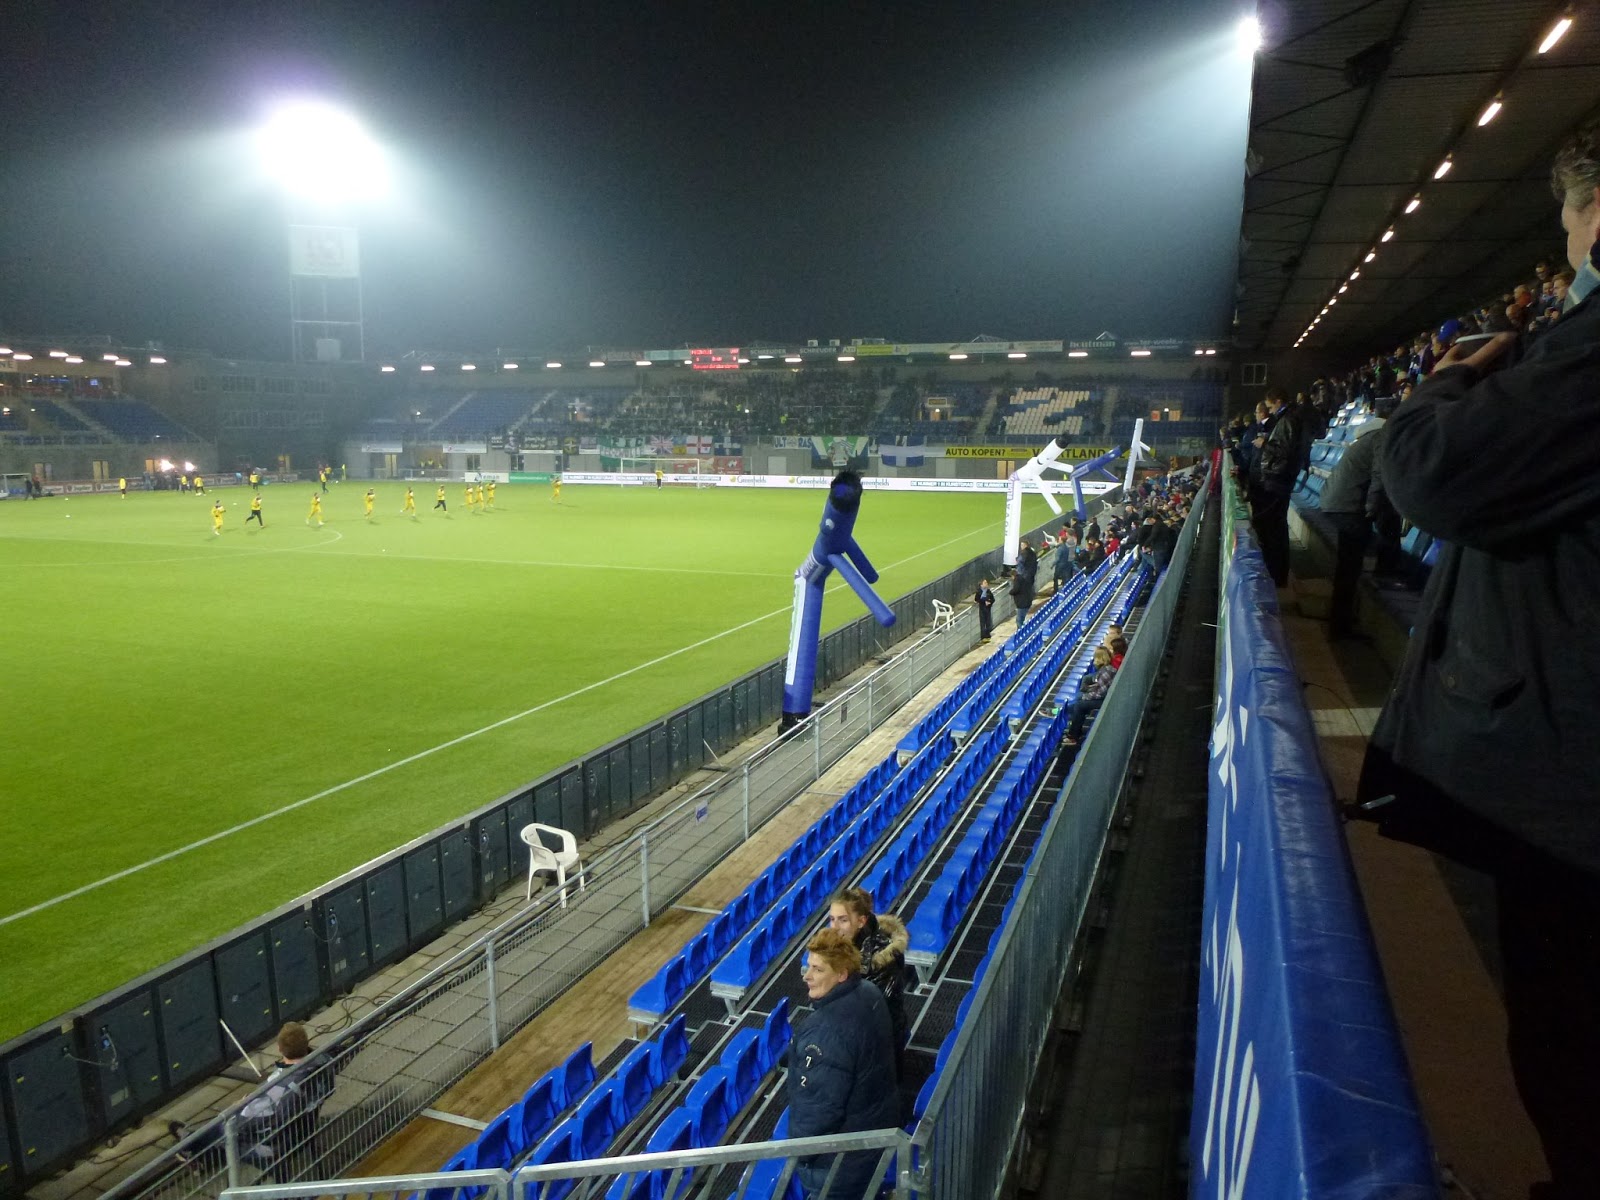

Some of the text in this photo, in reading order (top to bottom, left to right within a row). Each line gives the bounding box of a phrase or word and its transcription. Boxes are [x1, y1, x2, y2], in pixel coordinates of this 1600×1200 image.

[945, 448, 970, 456] AUTO
[971, 448, 1006, 457] KOPEN?
[800, 1075, 807, 1087] 2
